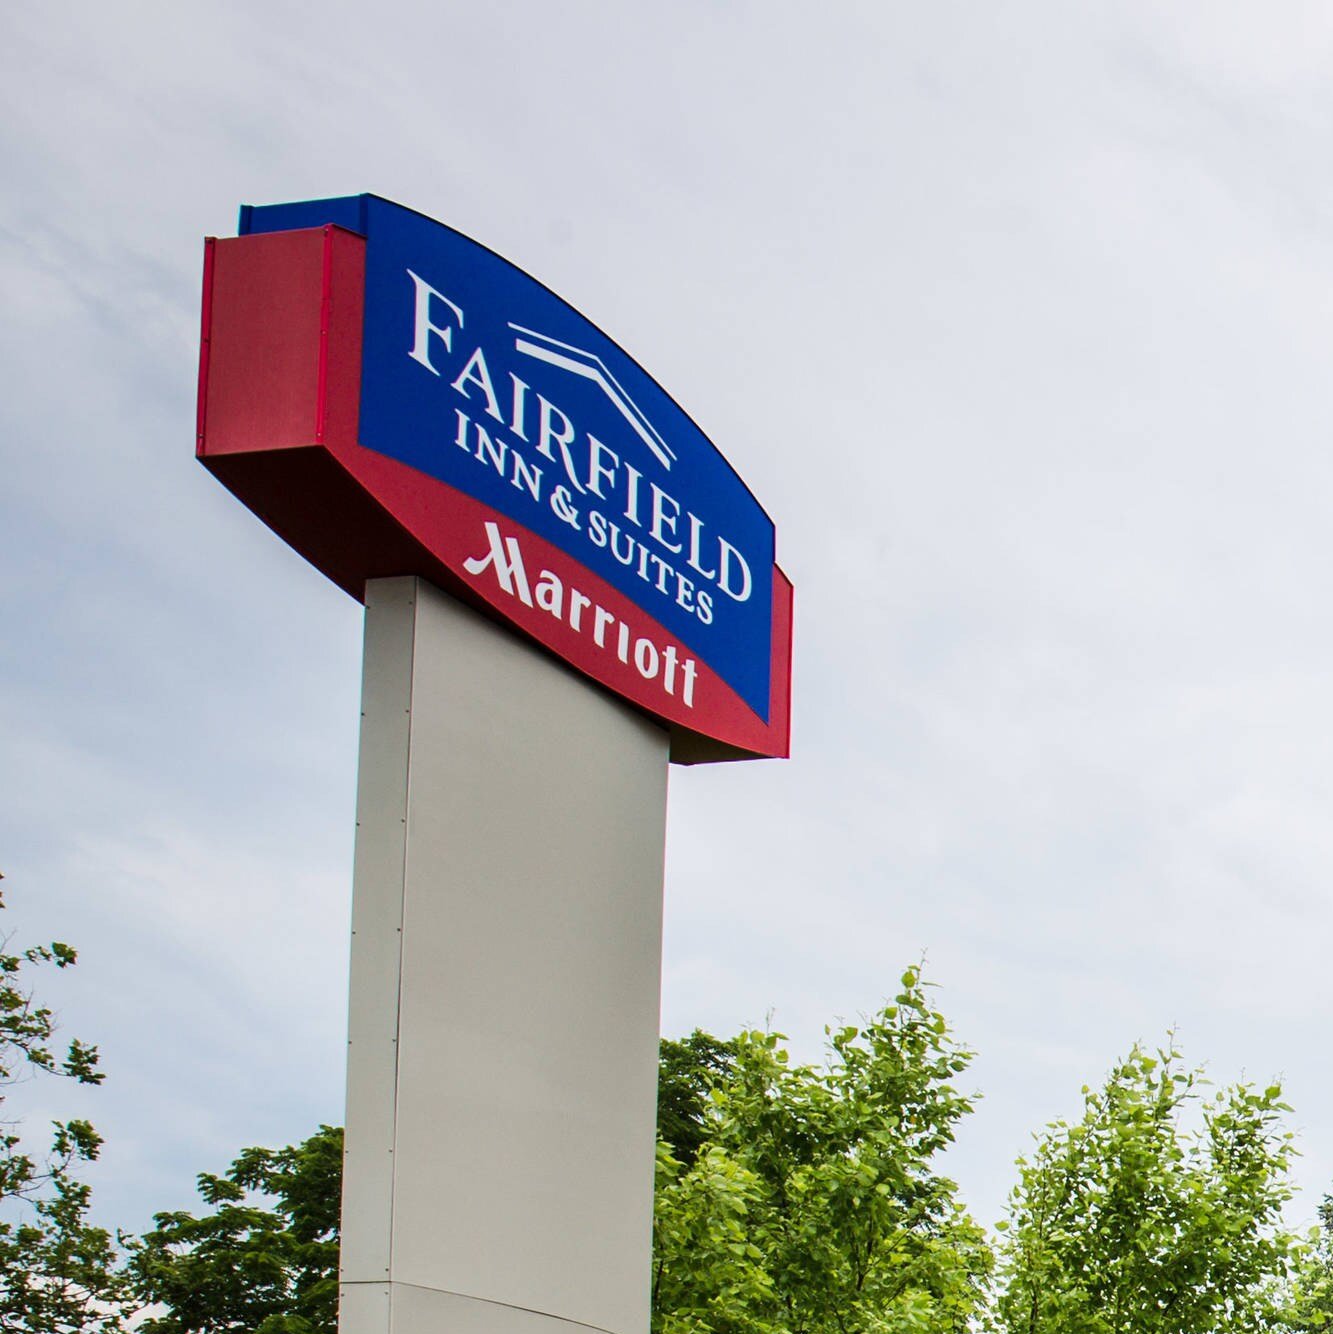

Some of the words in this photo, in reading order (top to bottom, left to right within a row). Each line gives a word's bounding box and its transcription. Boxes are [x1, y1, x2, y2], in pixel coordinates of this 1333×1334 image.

[406, 267, 753, 603] FAIRFIELD
[454, 408, 544, 503] INN
[550, 484, 582, 531] &
[588, 509, 714, 626] SUITES
[462, 521, 699, 709] Marriott
